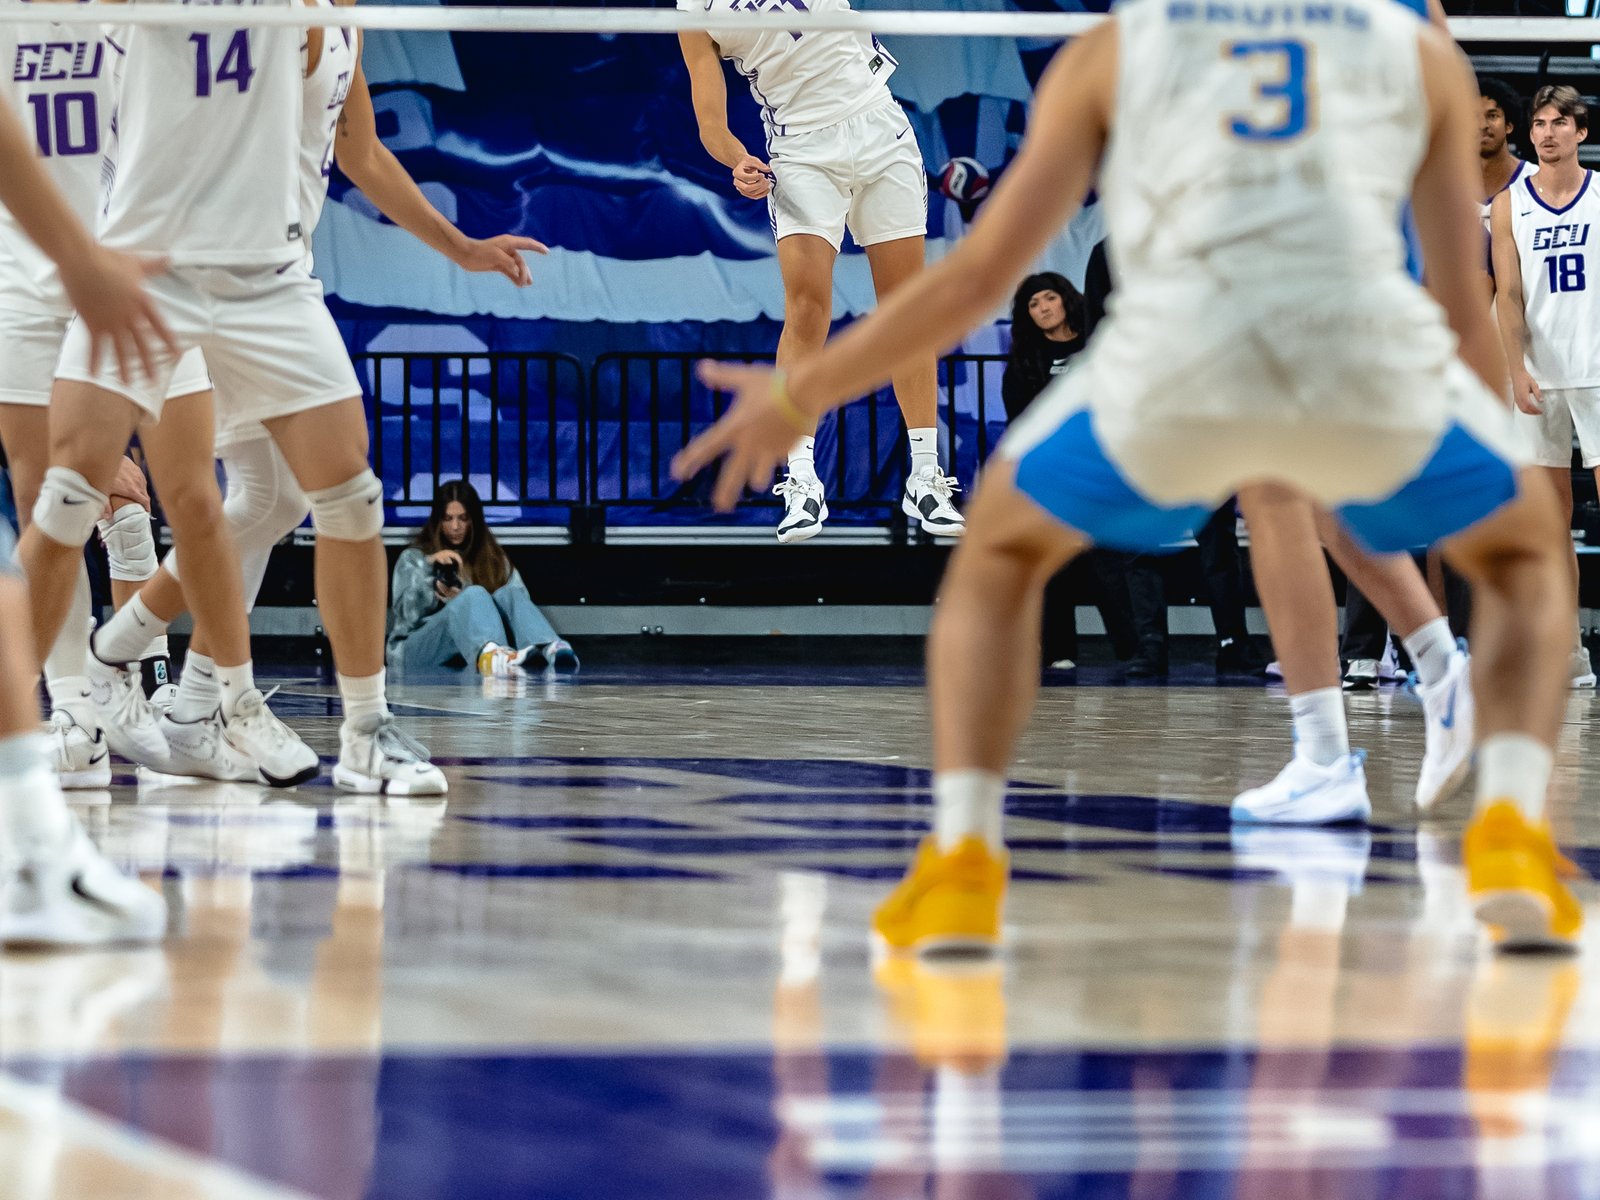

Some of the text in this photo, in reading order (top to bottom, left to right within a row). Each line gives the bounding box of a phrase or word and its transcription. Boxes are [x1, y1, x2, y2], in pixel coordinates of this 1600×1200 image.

[14, 42, 104, 82] GCU
[188, 28, 256, 97] 14
[1222, 36, 1318, 148] 3
[27, 91, 100, 157] 10
[1533, 224, 1590, 251] GCU
[1543, 253, 1586, 294] 18
